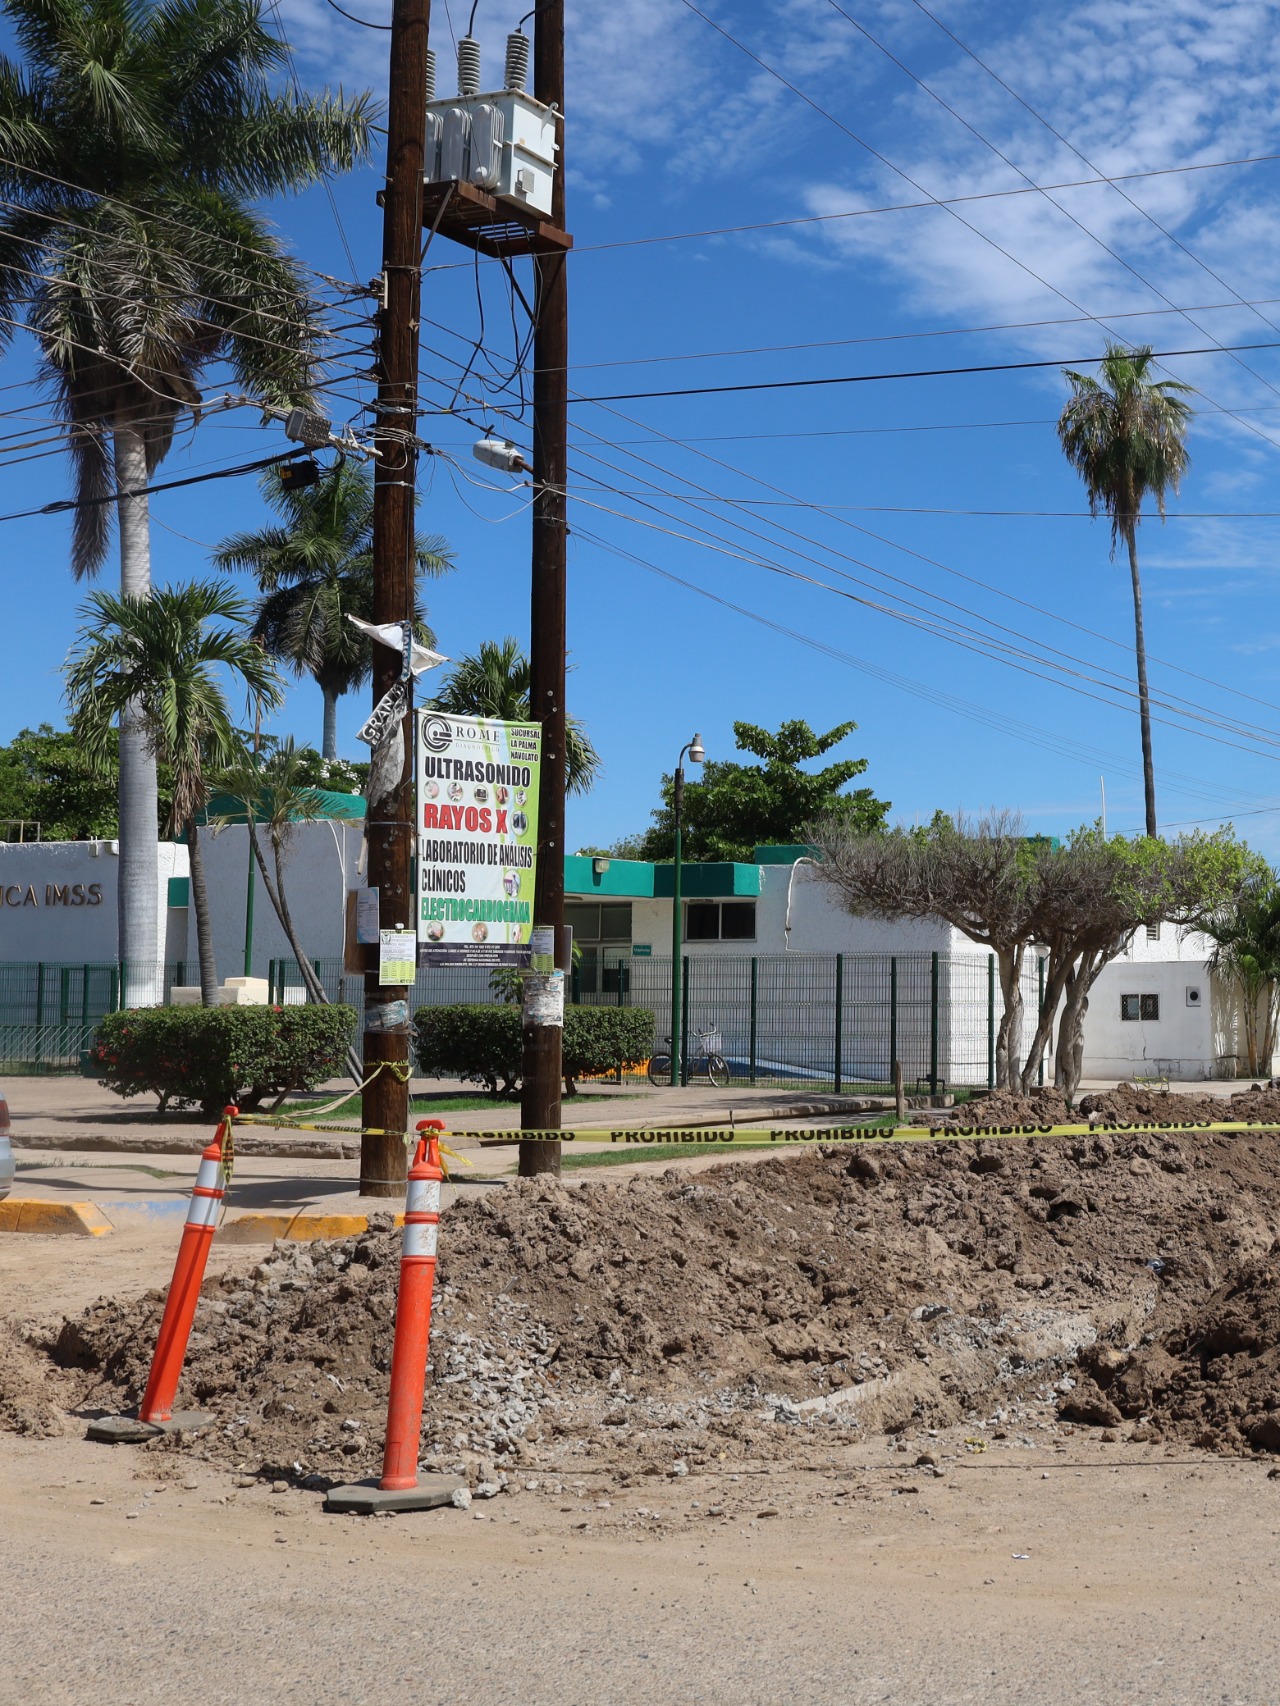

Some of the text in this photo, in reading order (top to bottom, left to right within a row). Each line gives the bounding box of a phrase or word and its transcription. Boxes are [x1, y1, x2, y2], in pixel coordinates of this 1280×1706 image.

[362, 696, 394, 740] GRAN
[456, 726, 500, 742] ROME
[510, 728, 541, 739] SUCURSAL
[510, 740, 537, 751] LA PALMA
[510, 751, 539, 762] NAVOLATO
[424, 756, 531, 788] ULTRASONIDO
[424, 803, 508, 834] RAYOS X
[421, 838, 533, 868] LABORATORIO DE ANÁLISIS
[421, 865, 466, 893] CLÍNICOS
[45, 883, 103, 906] IMSS
[420, 897, 531, 924] ELECTROCARDIOGRAMA
